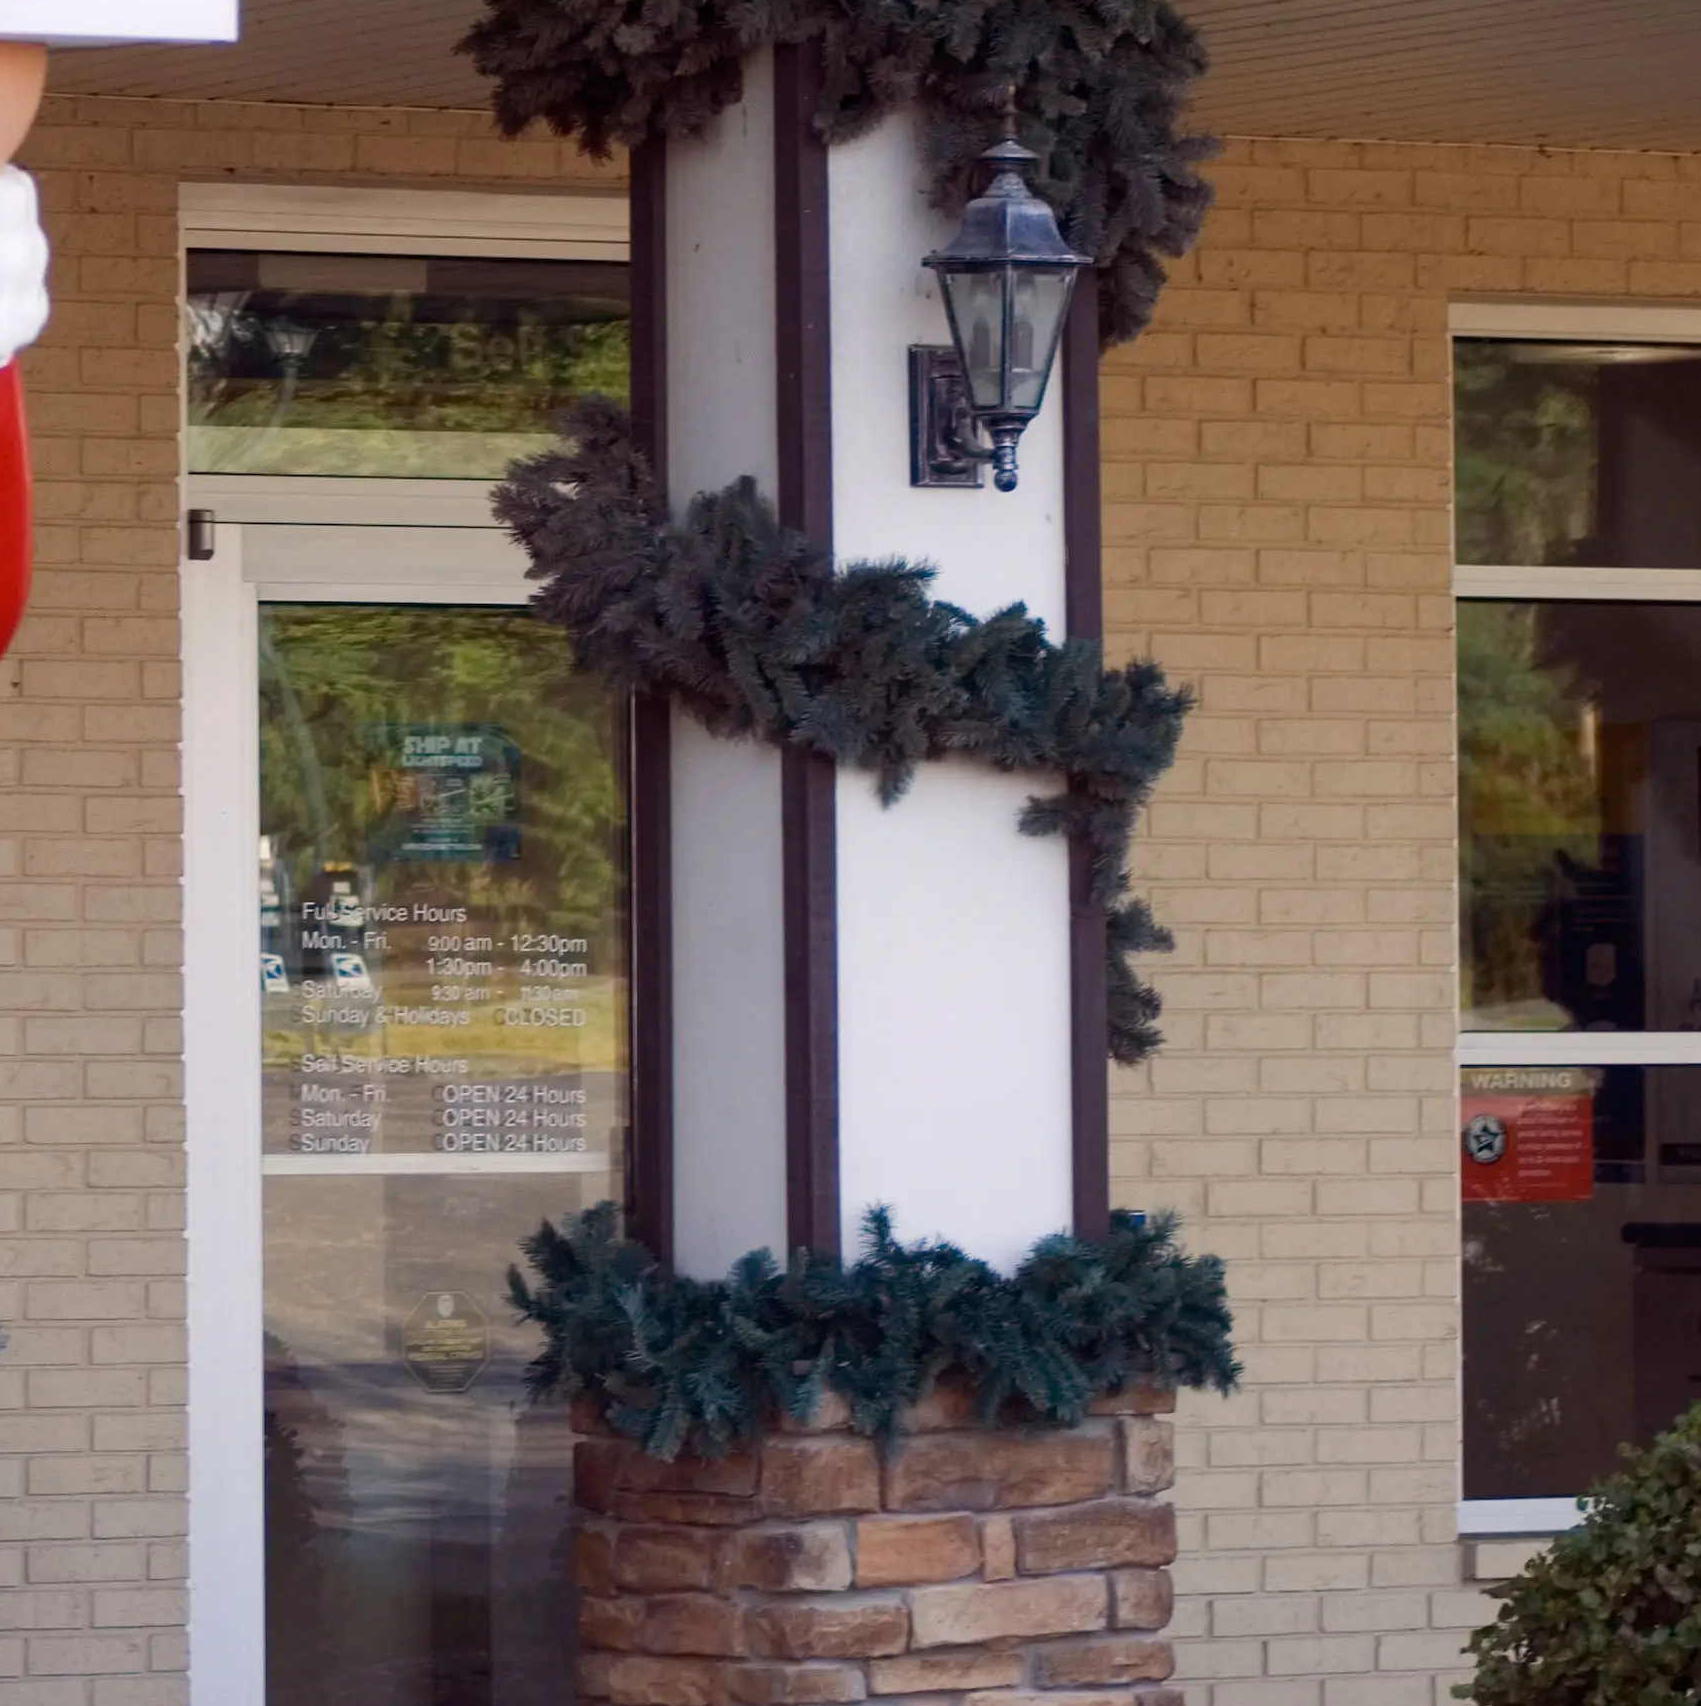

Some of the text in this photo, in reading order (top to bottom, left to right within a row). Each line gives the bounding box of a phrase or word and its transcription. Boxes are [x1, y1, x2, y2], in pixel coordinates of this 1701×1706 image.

[412, 904, 468, 923] Hours
[302, 931, 347, 949] Mon.
[363, 932, 392, 950] Fri.
[302, 980, 382, 1003] Saturday
[302, 1005, 587, 1028] Sunday & Holidays CLOSED
[414, 1056, 469, 1074] Hours
[1471, 1072, 1572, 1090] WARNING
[302, 1083, 346, 1102] Mon.
[363, 1084, 392, 1102] Fri.
[442, 1084, 500, 1104] OPEN
[504, 1085, 529, 1104] 24
[532, 1085, 588, 1104] Hours
[302, 1108, 588, 1132] Saturday OPEN 24 Hours
[302, 1133, 588, 1154] Sunday OPEN 24 Hours
